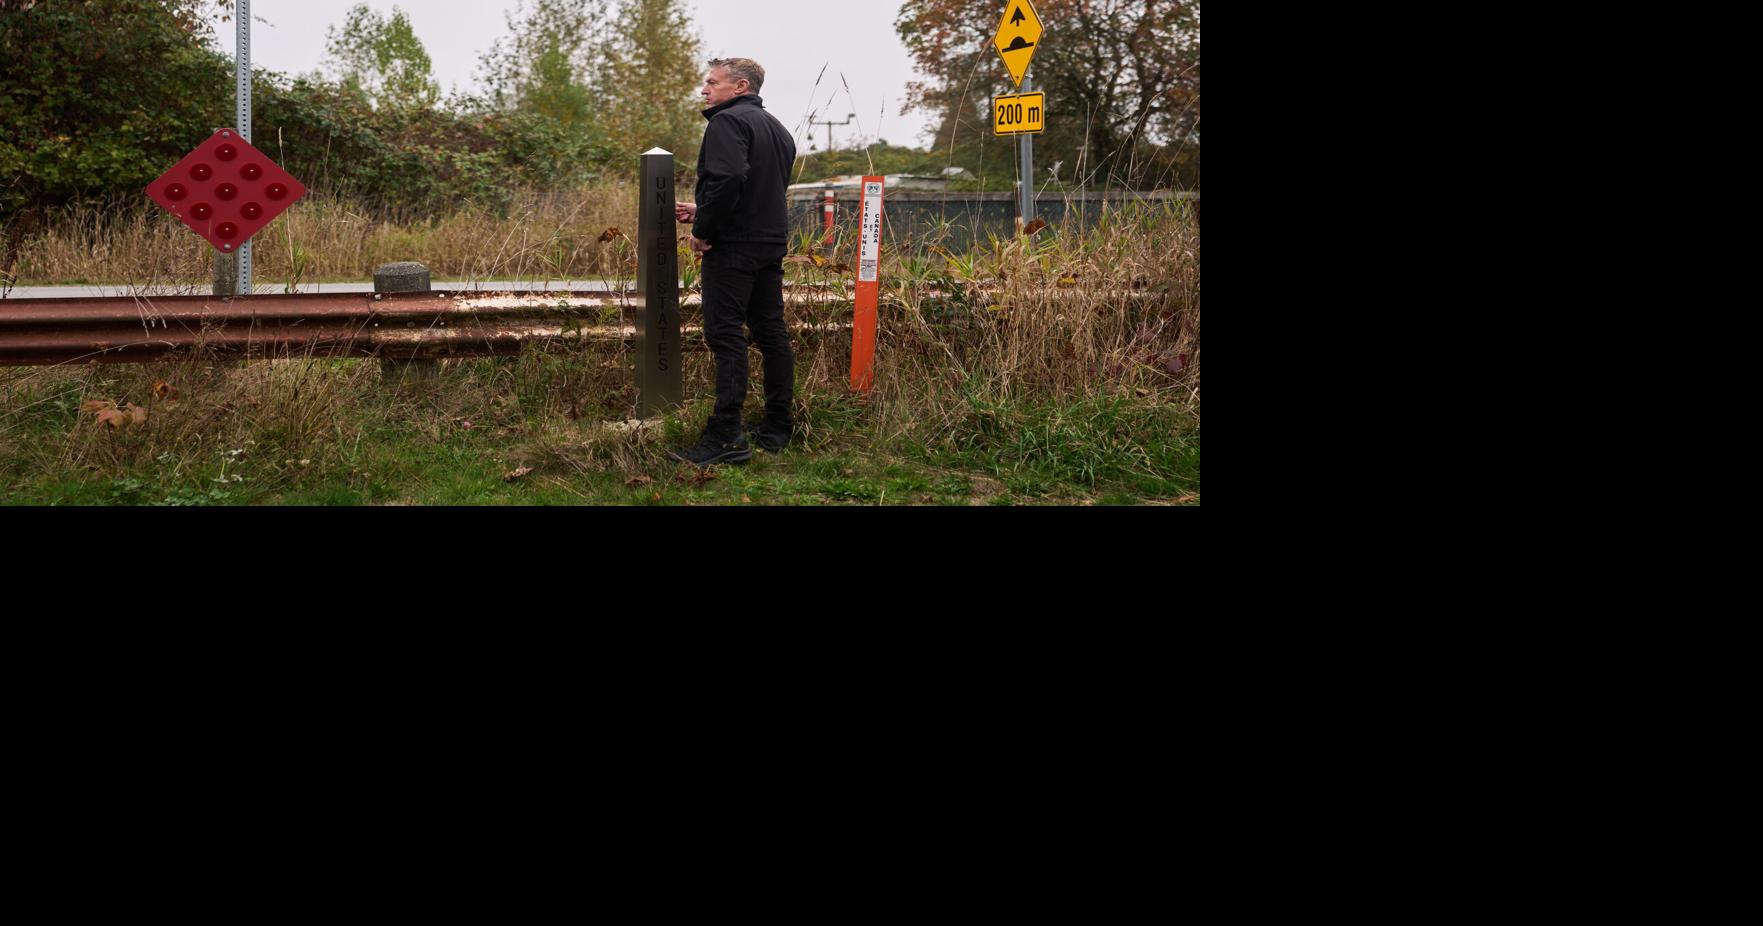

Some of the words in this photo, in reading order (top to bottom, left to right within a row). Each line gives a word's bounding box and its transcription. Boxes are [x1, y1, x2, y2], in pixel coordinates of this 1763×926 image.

[998, 103, 1022, 125] 200
[1028, 106, 1040, 123] m
[656, 176, 667, 266] UNITED
[656, 282, 668, 372] STATES
